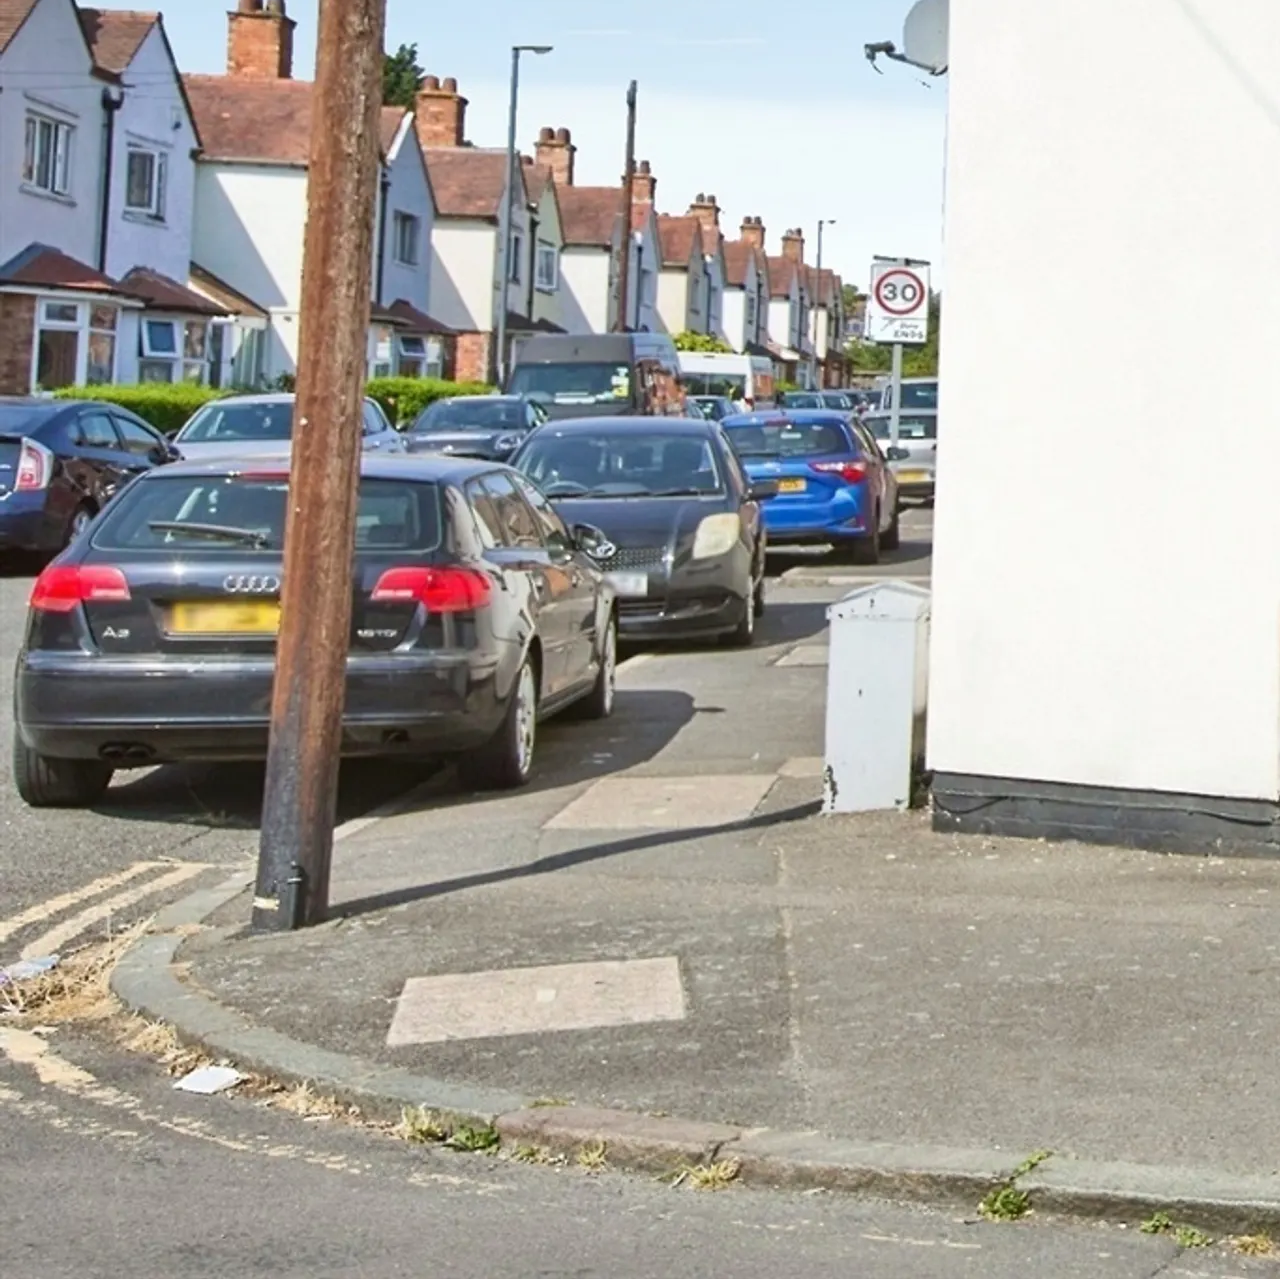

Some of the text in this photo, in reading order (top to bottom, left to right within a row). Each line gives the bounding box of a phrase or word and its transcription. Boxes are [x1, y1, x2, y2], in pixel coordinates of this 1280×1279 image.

[883, 282, 917, 302] 30
[893, 330, 924, 340] ENDS
[102, 625, 130, 639] A3
